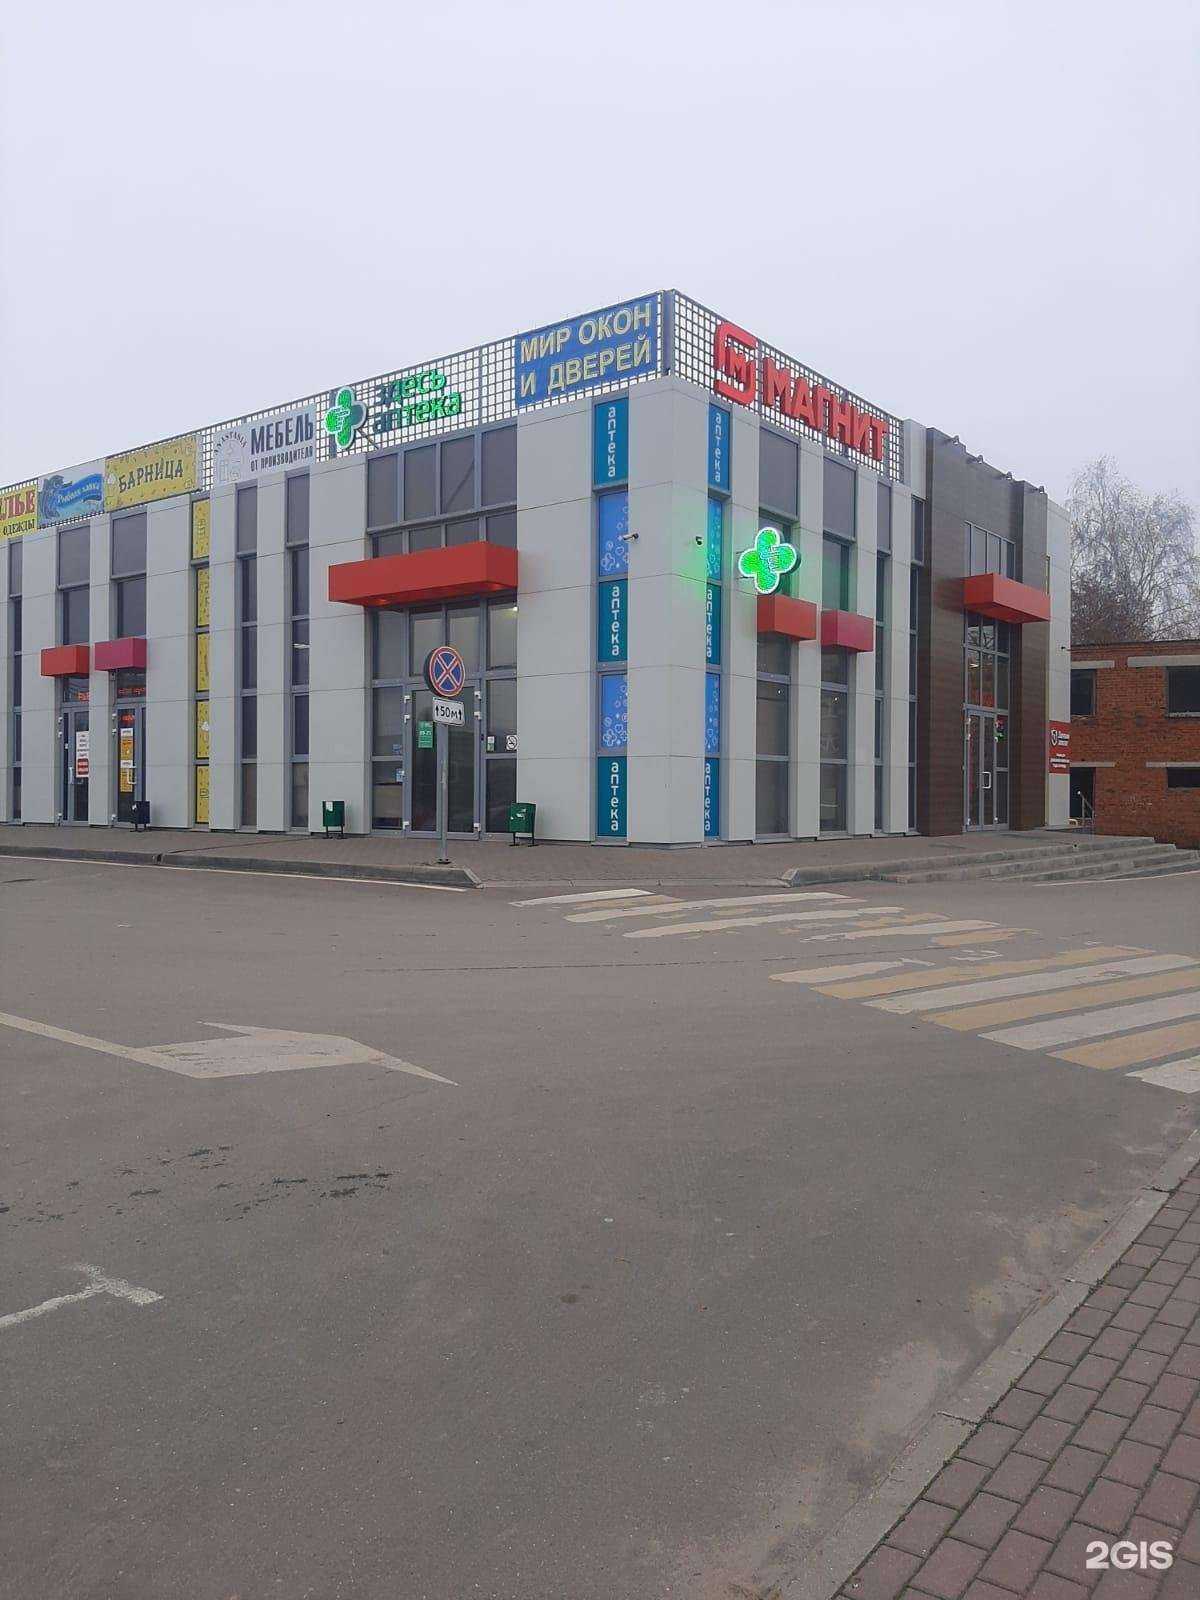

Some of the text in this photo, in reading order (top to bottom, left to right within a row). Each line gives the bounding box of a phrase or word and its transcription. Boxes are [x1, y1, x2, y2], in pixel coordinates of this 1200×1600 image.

[521, 303, 651, 363] МИР ОКОН
[521, 335, 651, 397] И ДВЕРЕЙ
[251, 413, 314, 455] МЕБЕЛЬ
[607, 406, 616, 477] аптека
[763, 357, 888, 461] МАГНИТ
[611, 586, 620, 656] аптека
[610, 762, 619, 831] аптека
